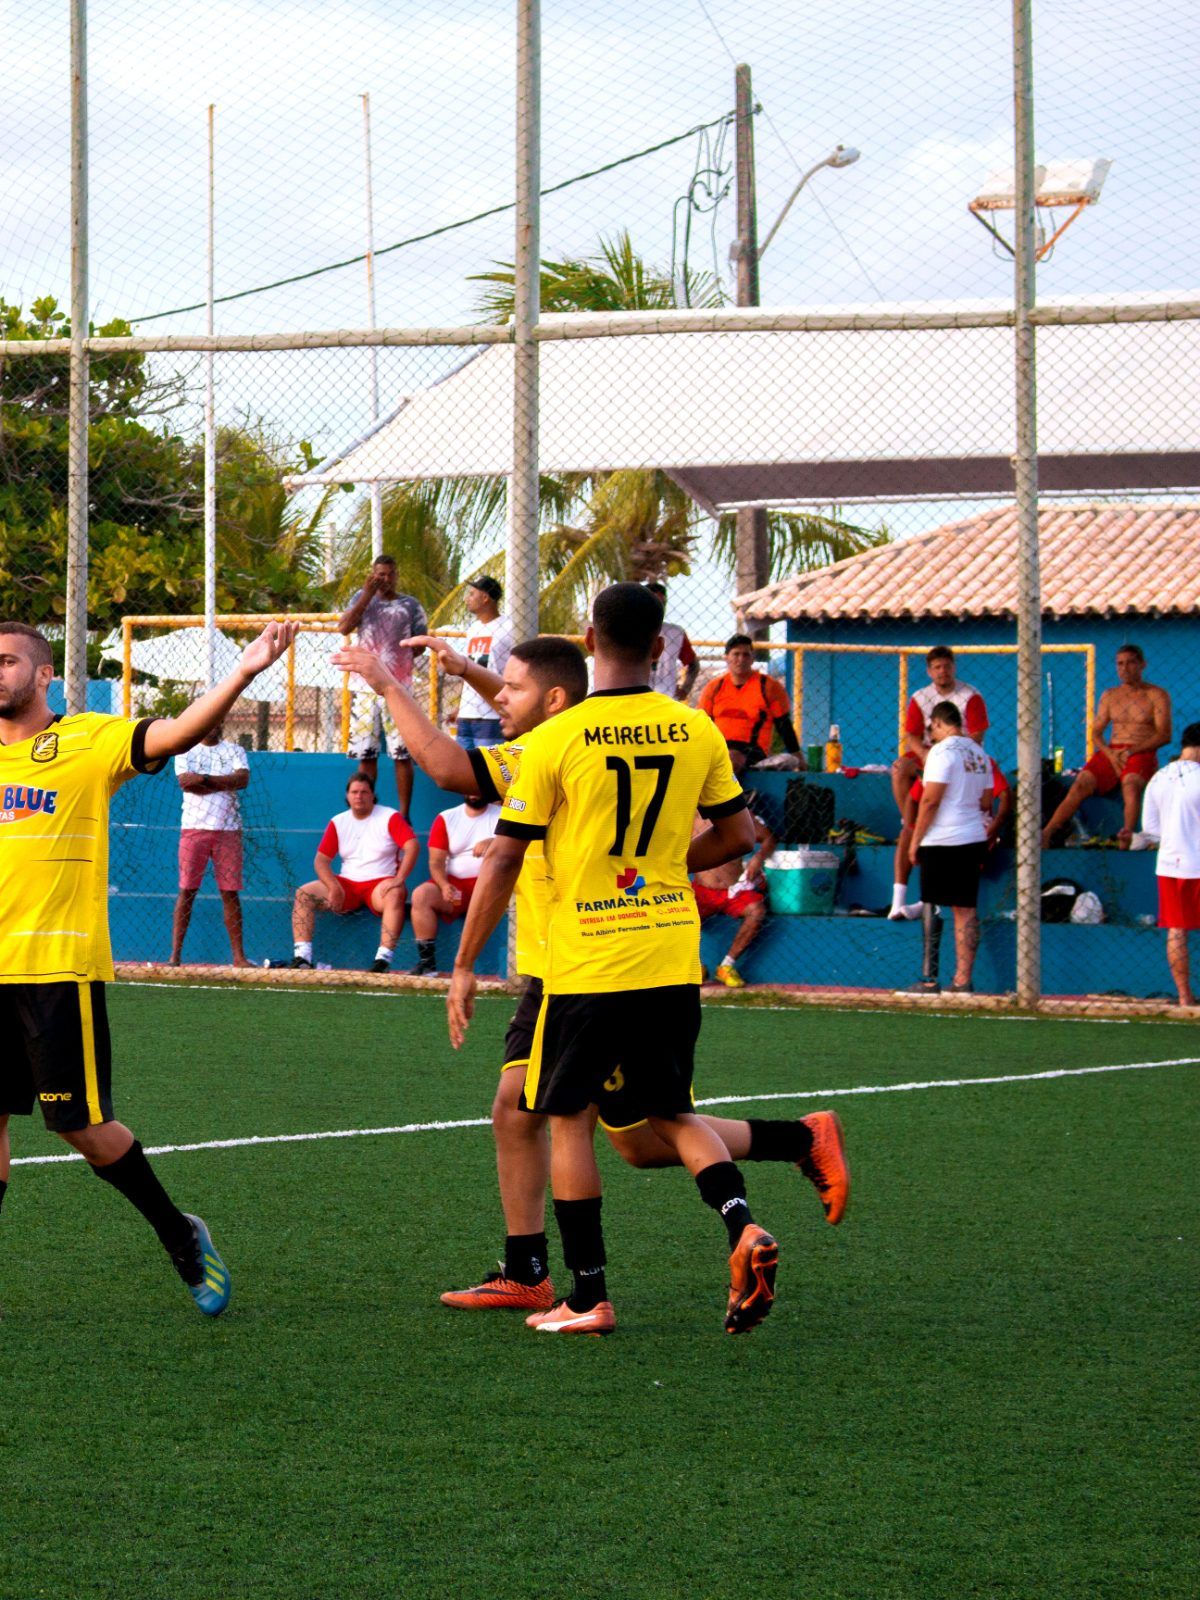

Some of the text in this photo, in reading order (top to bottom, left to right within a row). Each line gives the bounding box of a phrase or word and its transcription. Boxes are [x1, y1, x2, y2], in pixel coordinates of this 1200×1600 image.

[584, 723, 689, 746] MEIRELLES
[3, 787, 58, 814] BLUE
[606, 754, 675, 857] 17
[576, 896, 650, 912] FARMÁCIA
[653, 892, 684, 905] DENY
